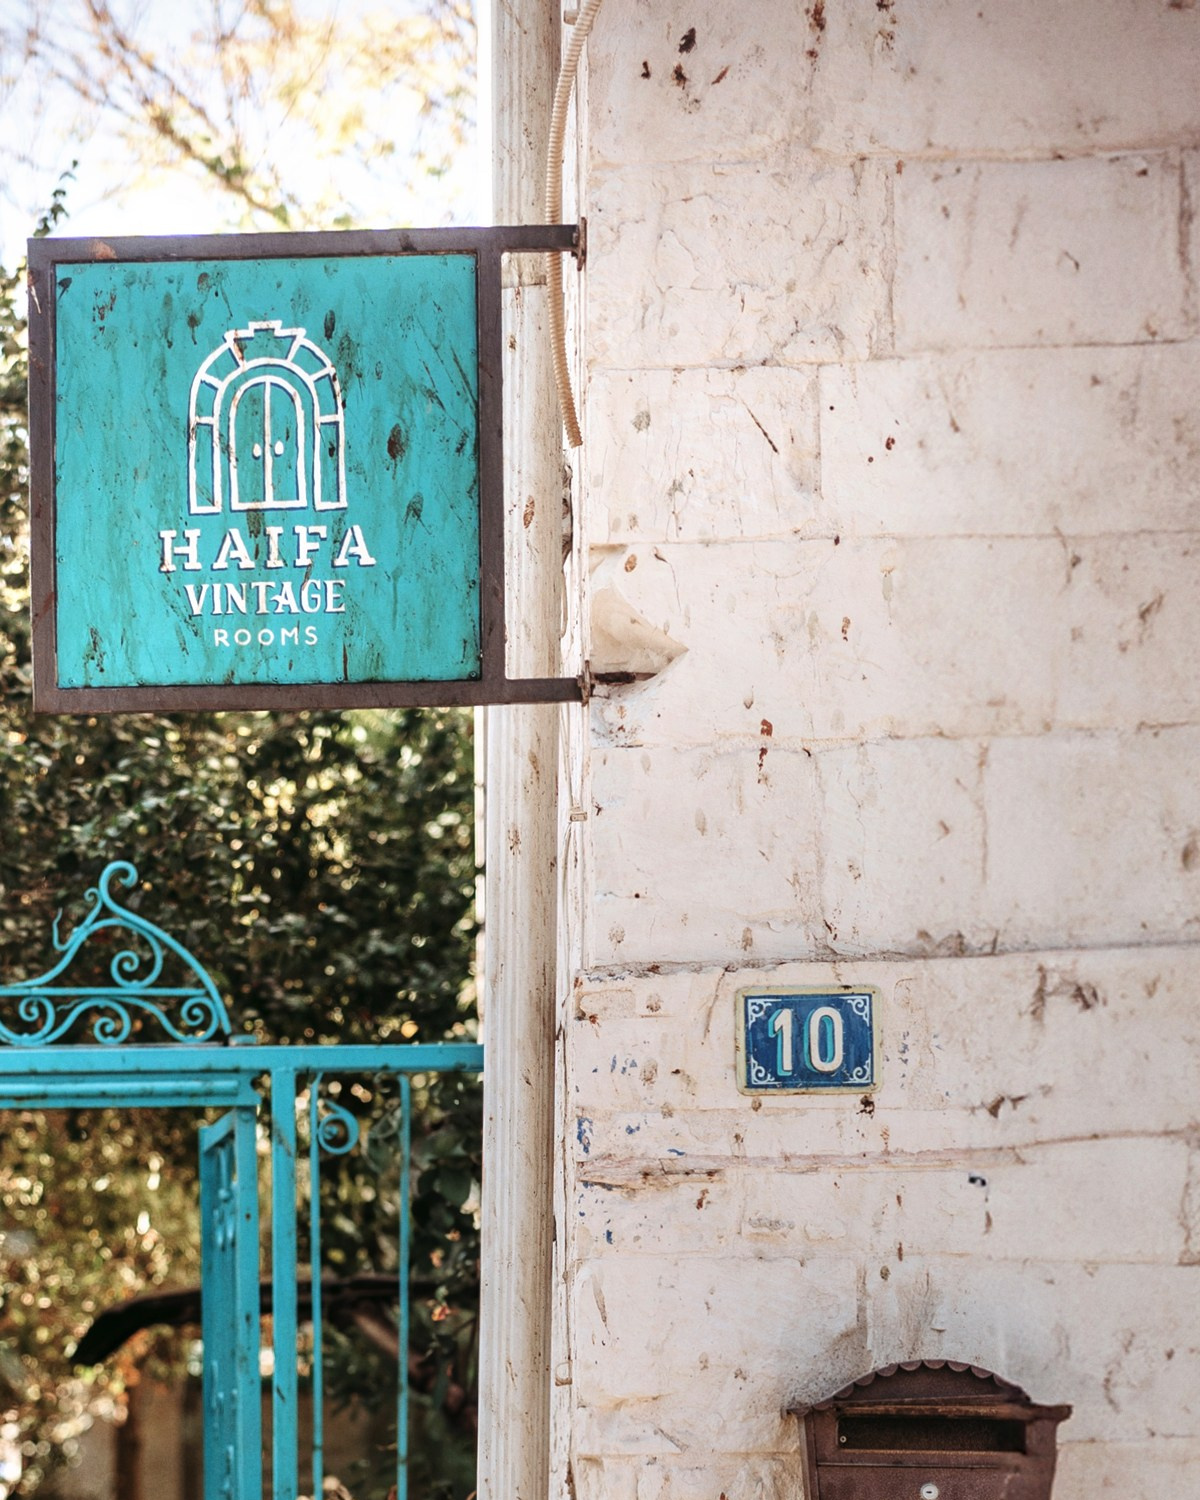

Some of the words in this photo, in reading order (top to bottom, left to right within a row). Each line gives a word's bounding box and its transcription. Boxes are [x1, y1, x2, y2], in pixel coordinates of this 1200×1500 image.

[158, 524, 377, 572] HAIFA
[183, 579, 347, 616] VINTAGE
[214, 625, 319, 647] ROOMS
[768, 1006, 843, 1076] 10
